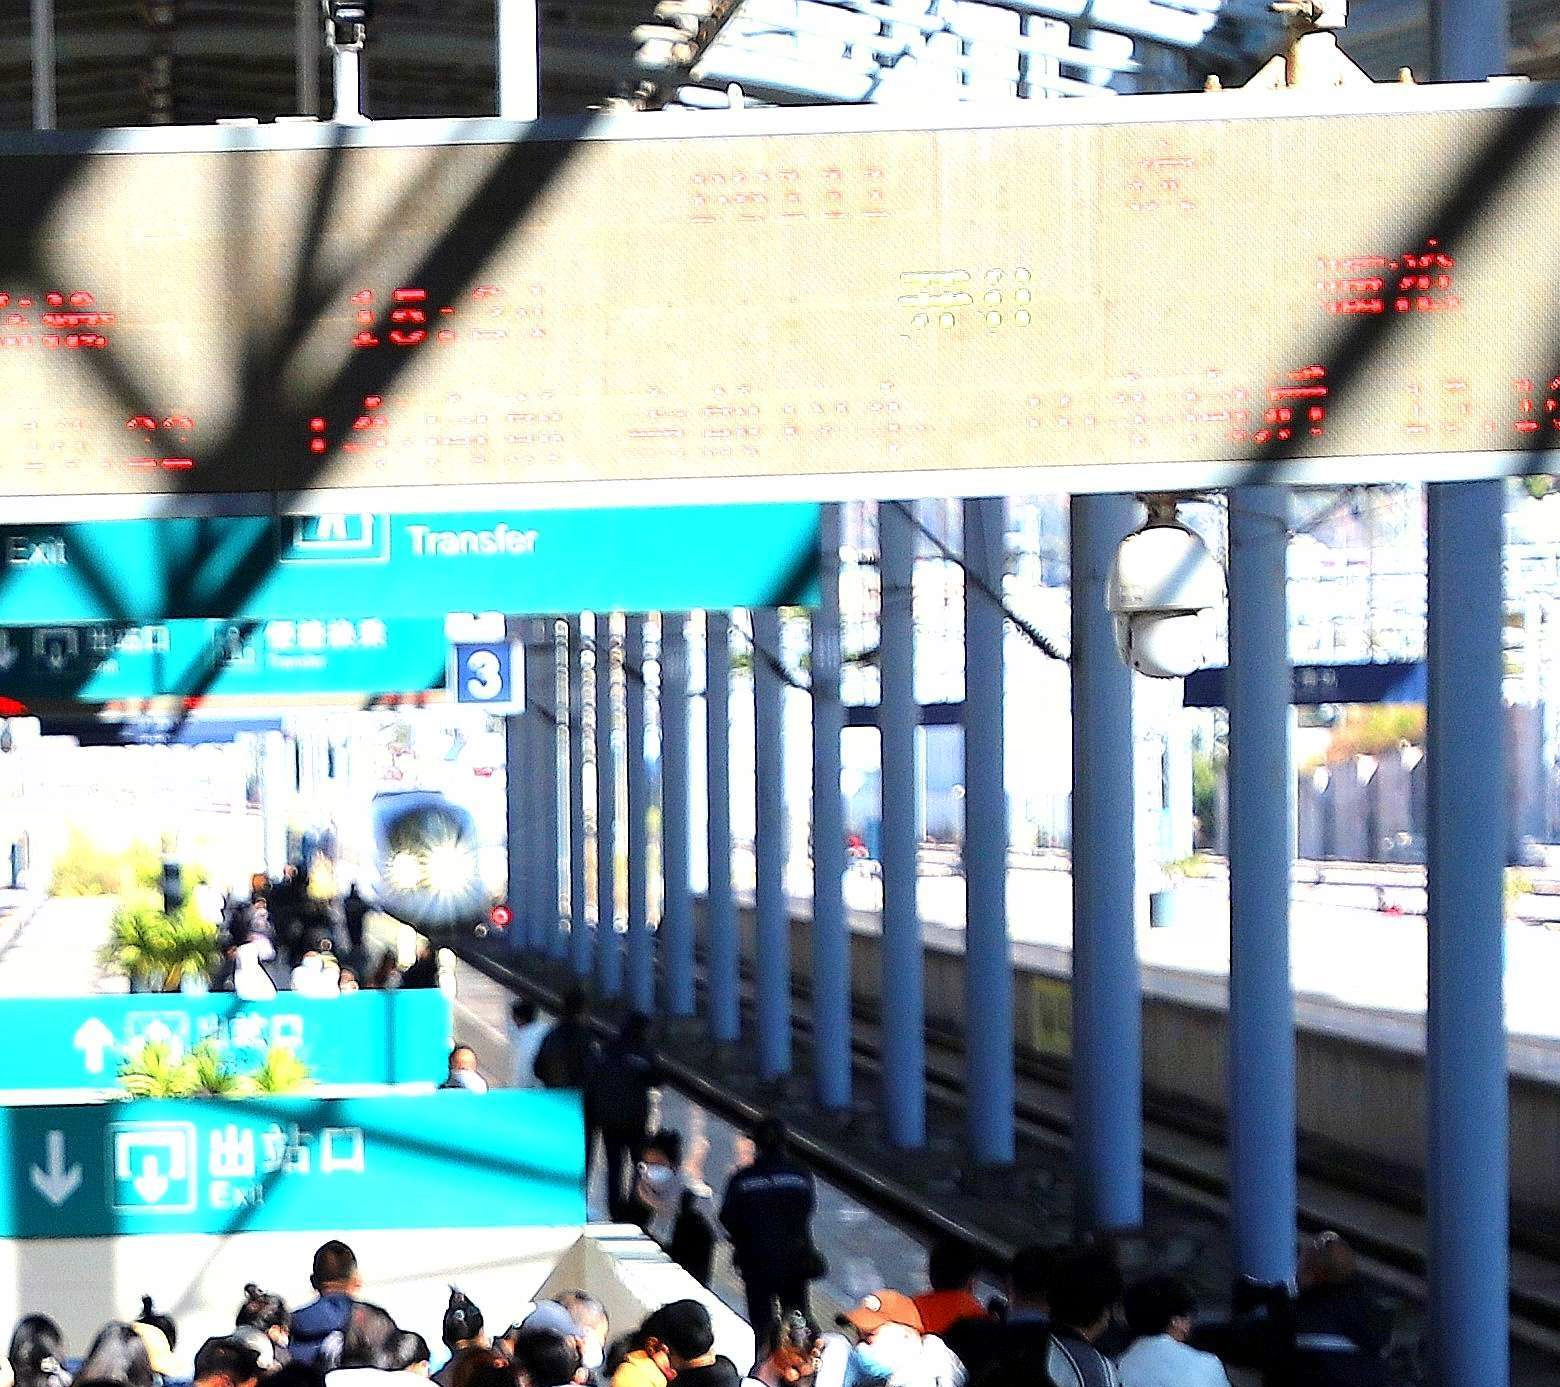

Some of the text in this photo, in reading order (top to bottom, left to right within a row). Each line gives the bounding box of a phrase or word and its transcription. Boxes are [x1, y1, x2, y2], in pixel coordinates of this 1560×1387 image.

[7, 536, 68, 566] Exit
[406, 522, 539, 557] Transfer
[466, 649, 504, 699] 3
[209, 1121, 366, 1178] 出站口
